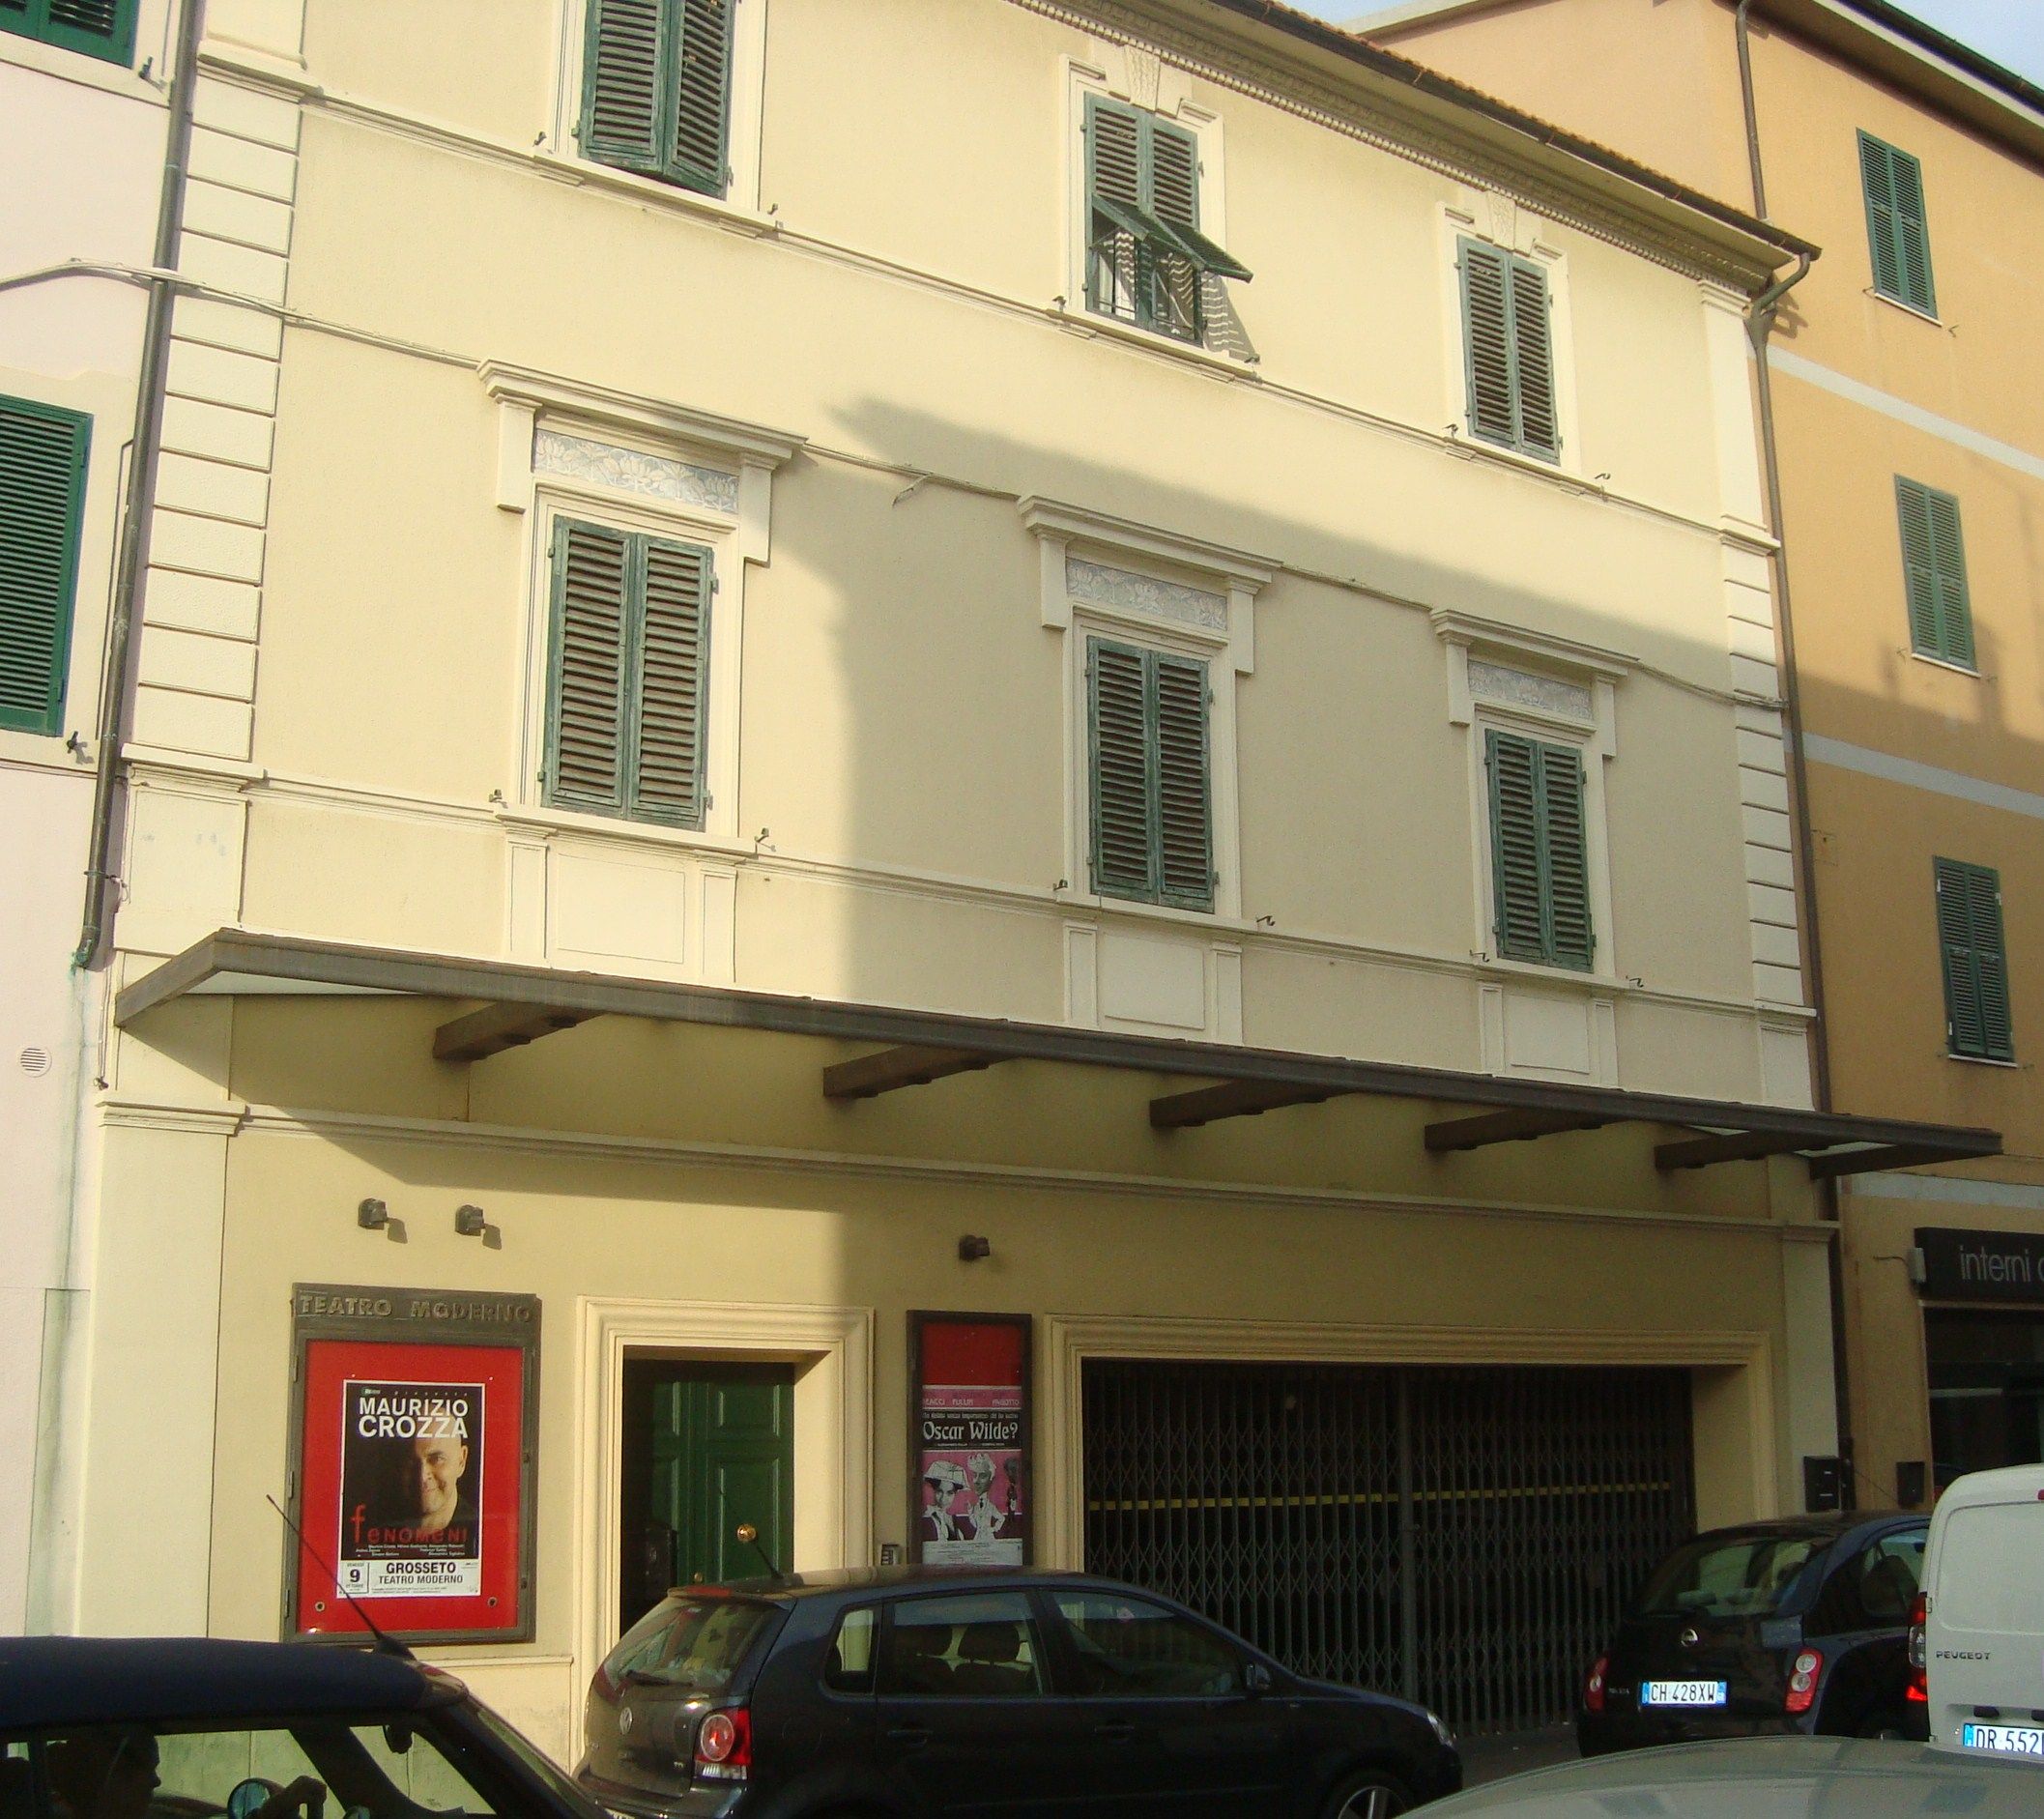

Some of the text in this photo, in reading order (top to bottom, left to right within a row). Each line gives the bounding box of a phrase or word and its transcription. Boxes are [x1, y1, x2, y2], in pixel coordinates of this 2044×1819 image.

[1959, 1245, 2031, 1283] interni
[299, 1294, 531, 1323] TEATRO MODERNO
[359, 1397, 469, 1417] MAURIZIO
[358, 1415, 469, 1438] CROZZA
[923, 1421, 1019, 1440] Oscar Wilde?
[349, 1569, 360, 1583] 9
[386, 1561, 457, 1574] GROSSETO
[378, 1574, 464, 1584] TEATRO MODERNO
[1936, 1650, 1991, 1660] PEUGEOT
[1651, 1684, 1716, 1702] CH 428XW
[1976, 1728, 2044, 1755] DR 552
